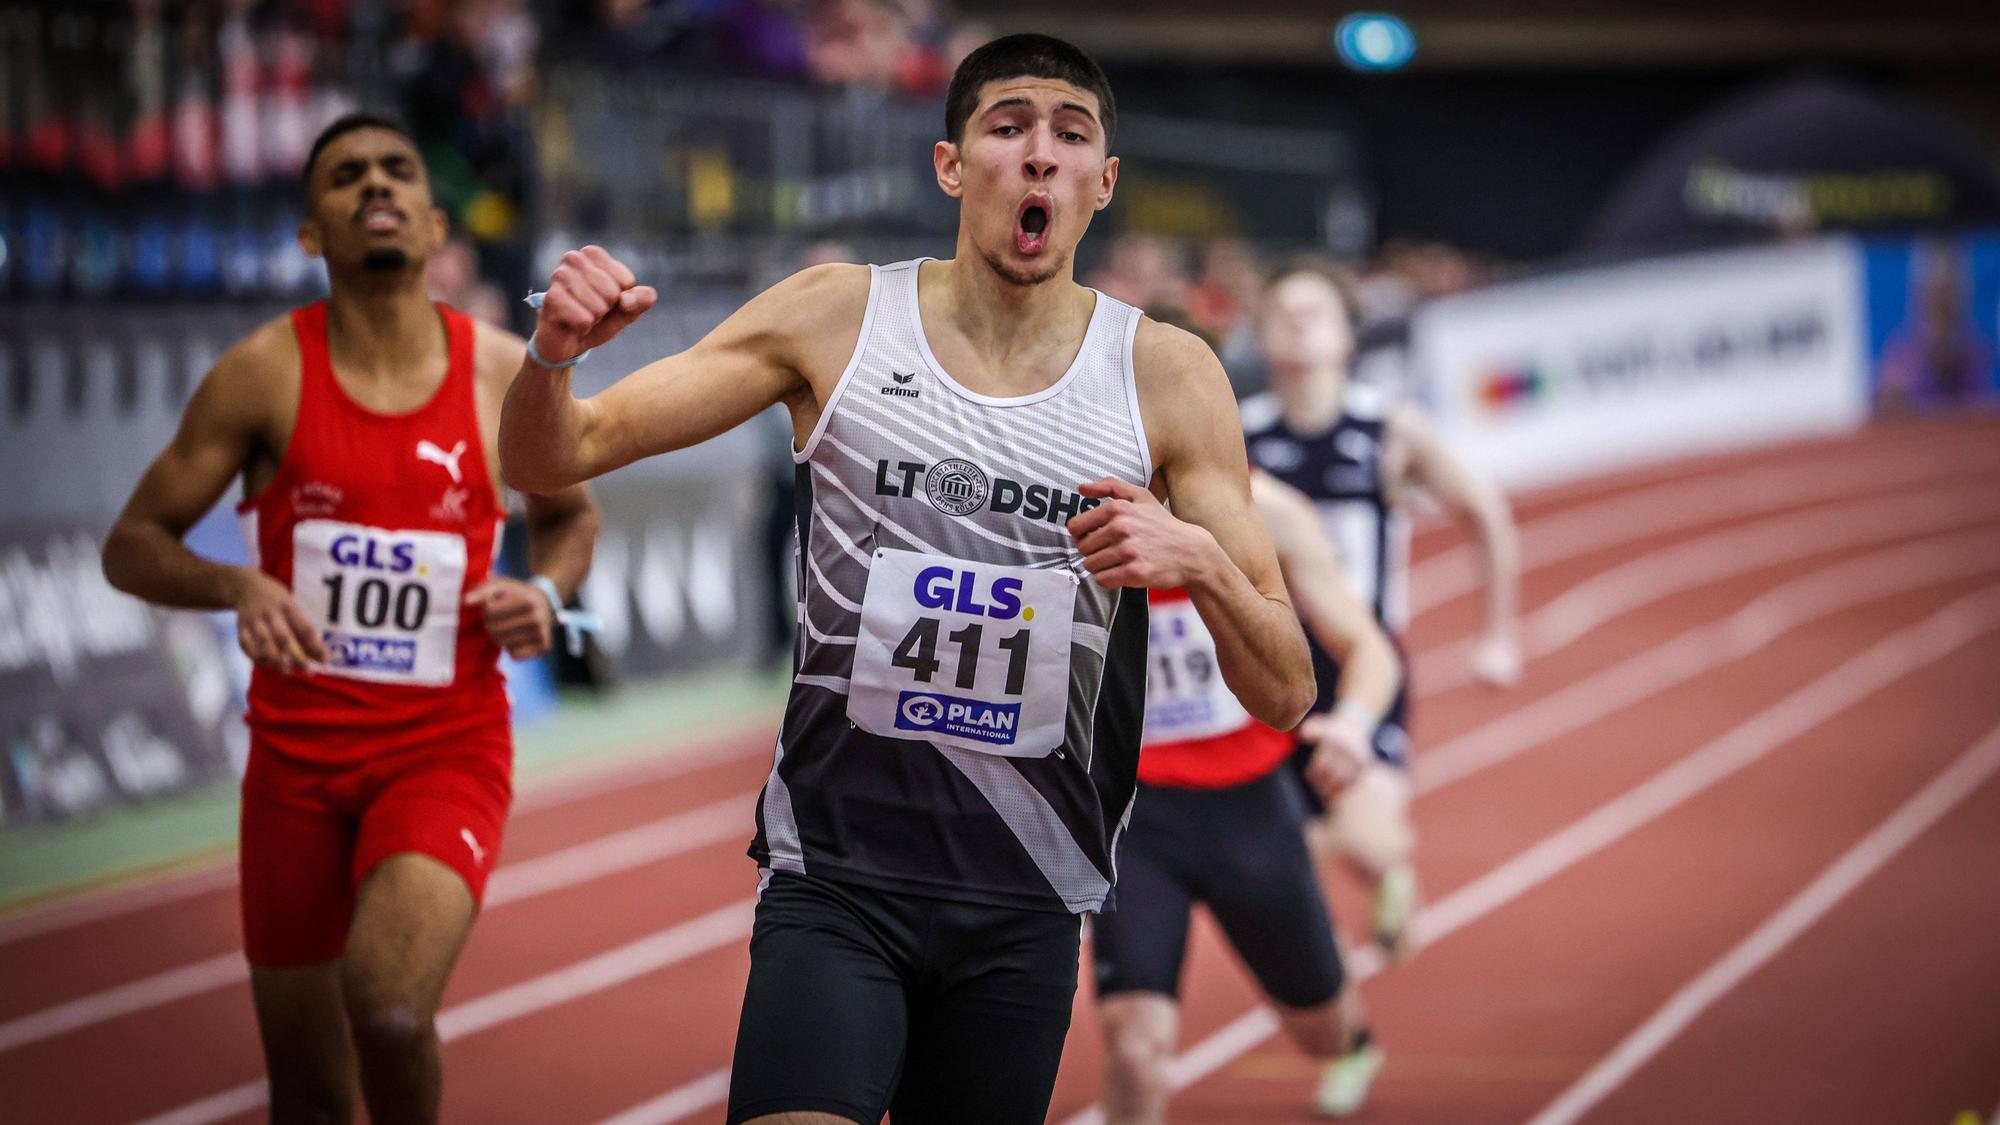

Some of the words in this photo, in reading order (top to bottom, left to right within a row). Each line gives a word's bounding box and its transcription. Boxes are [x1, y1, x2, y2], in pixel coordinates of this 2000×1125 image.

[881, 386, 919, 398] erima
[875, 459, 926, 498] LT
[322, 573, 429, 632] 100
[891, 616, 1031, 696] 411
[946, 723, 1011, 740] INTERNATIONAL
[948, 703, 1015, 730] PLAN
